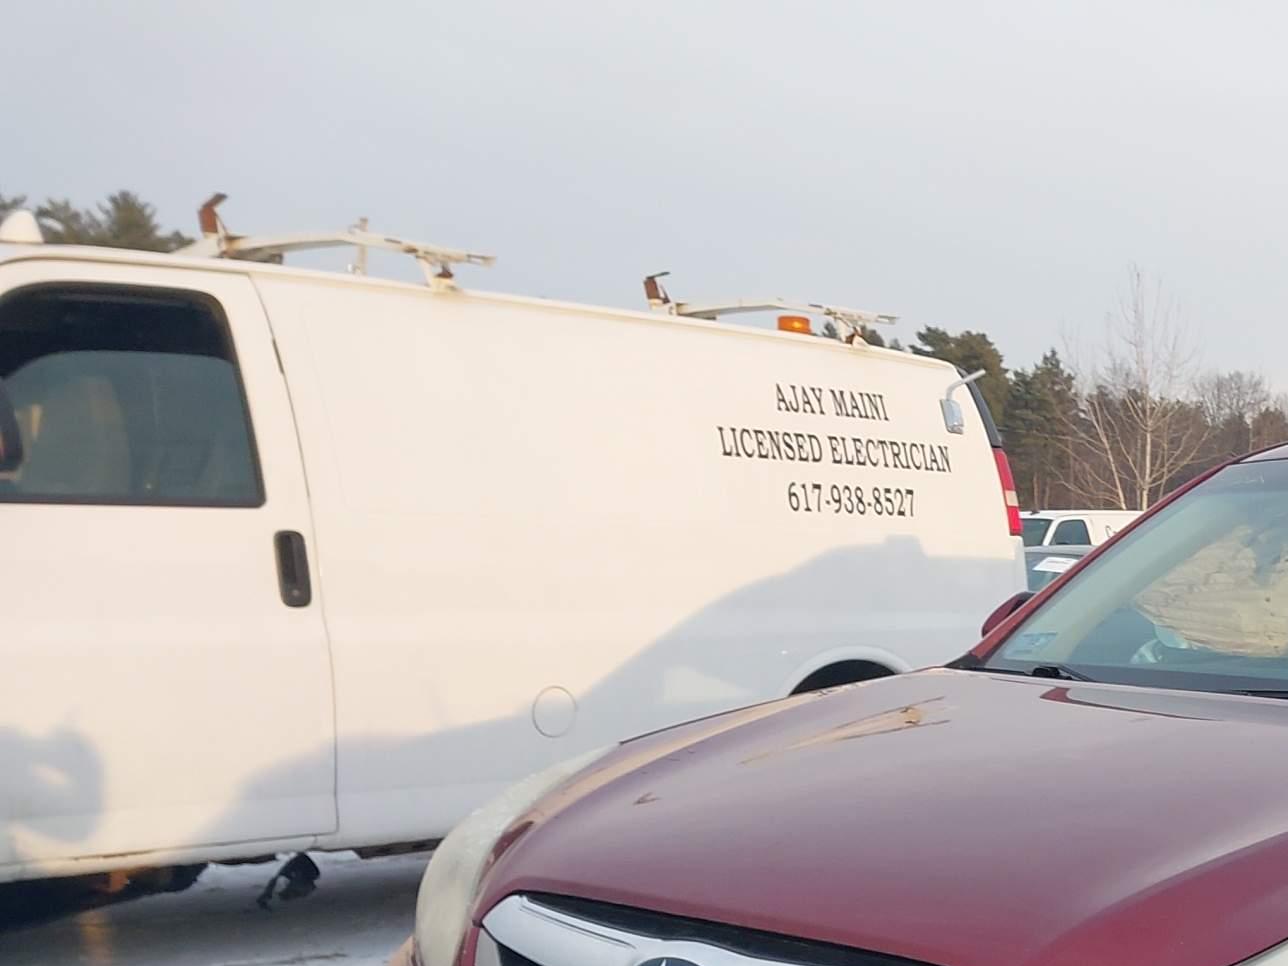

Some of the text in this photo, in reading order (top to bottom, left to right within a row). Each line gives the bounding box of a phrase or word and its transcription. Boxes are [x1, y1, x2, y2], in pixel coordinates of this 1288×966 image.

[775, 382, 890, 421] AJAY MAINI
[716, 426, 952, 473] LICENSED ELECTRICIAN
[787, 481, 915, 517] 617-938-8527
